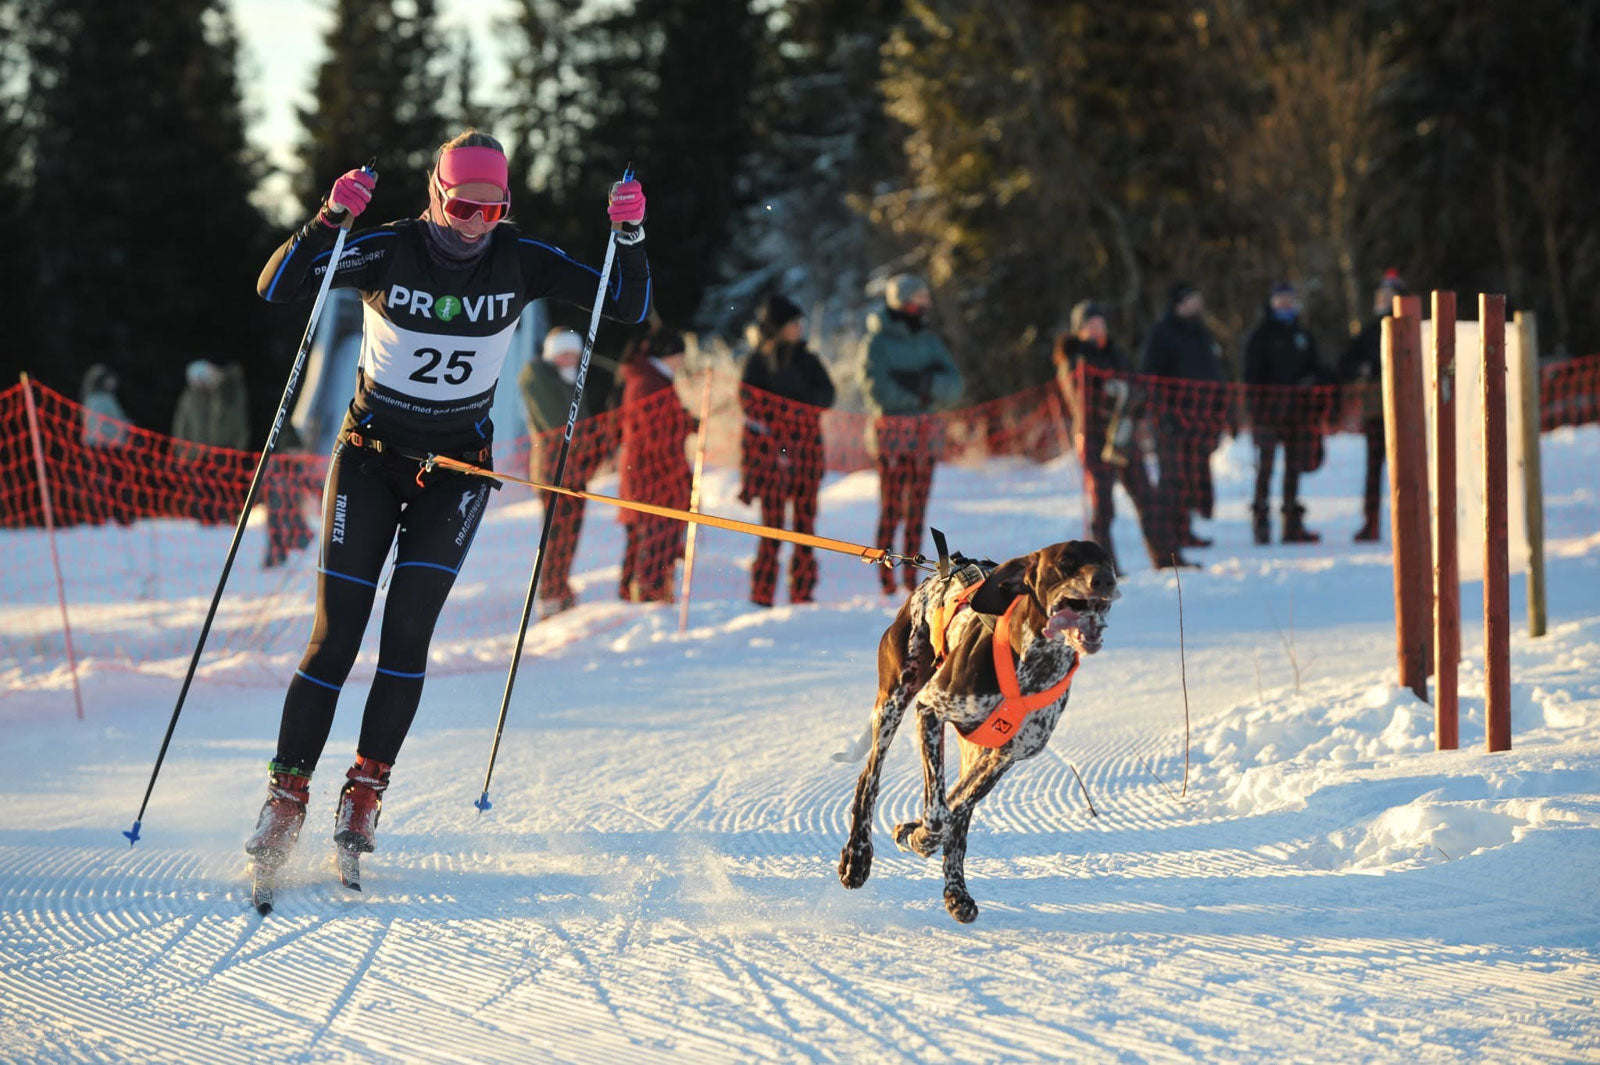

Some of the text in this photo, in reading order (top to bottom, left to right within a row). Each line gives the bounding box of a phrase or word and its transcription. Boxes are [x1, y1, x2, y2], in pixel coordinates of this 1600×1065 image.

[387, 284, 515, 322] PROVIT
[408, 347, 477, 386] 25
[370, 389, 411, 410] Hundemat
[412, 405, 432, 415] med
[331, 494, 348, 545] TRIMTEX
